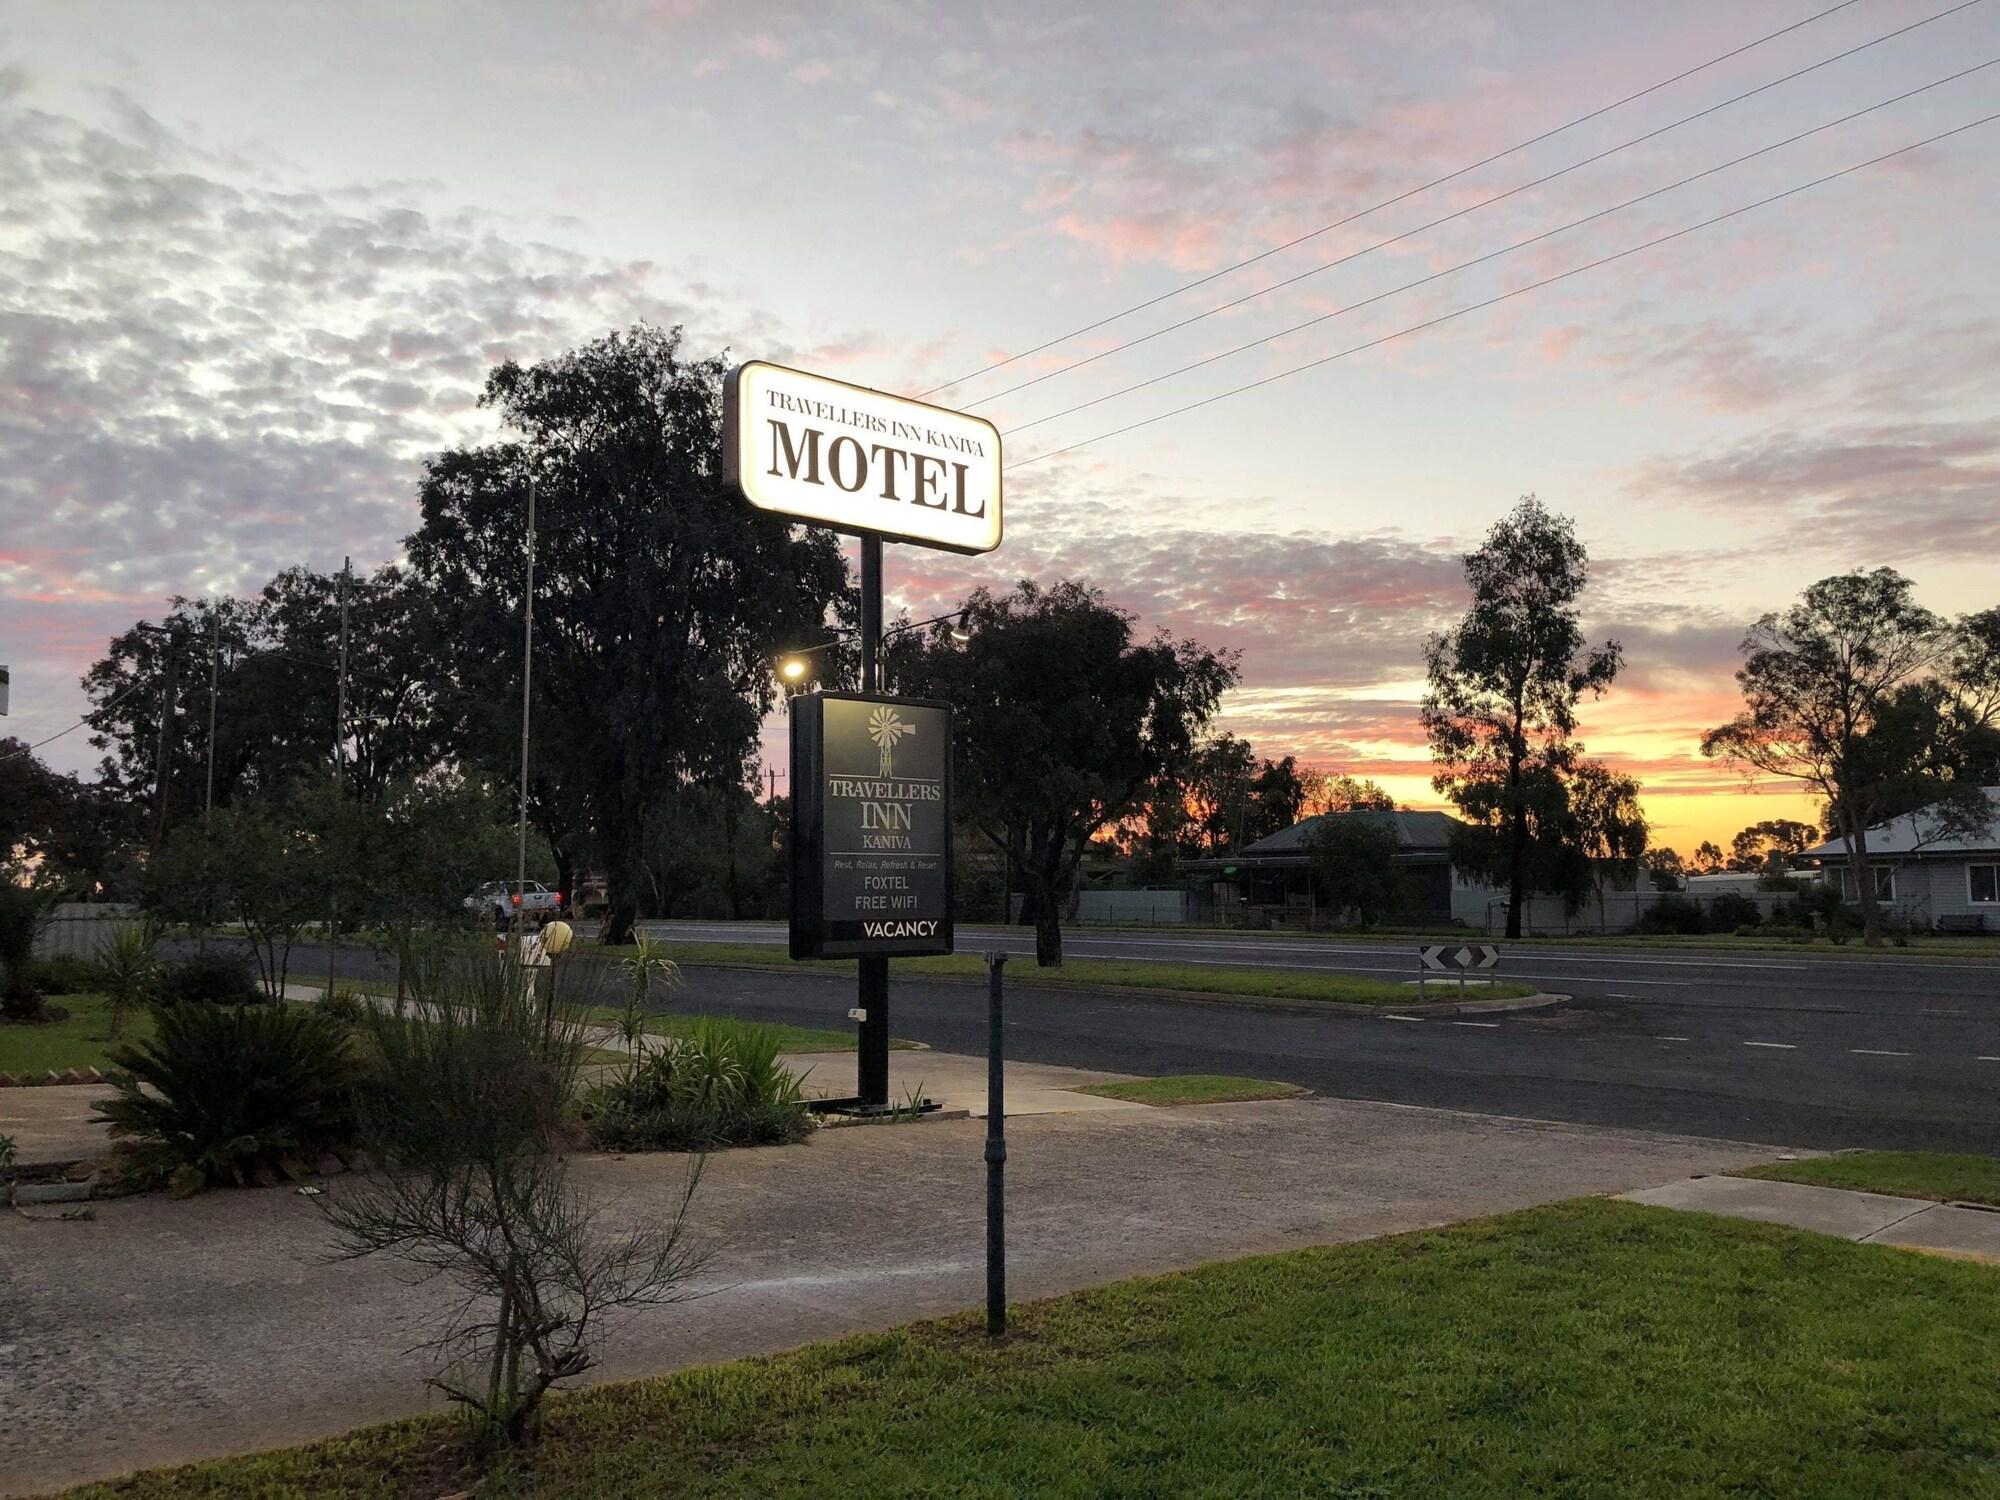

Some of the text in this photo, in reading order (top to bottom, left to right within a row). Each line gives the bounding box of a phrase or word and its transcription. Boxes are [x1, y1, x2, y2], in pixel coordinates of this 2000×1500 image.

[767, 390, 984, 457] TRAVELLERS INN KANIVA
[767, 419, 985, 518] MOTEL
[829, 780, 940, 800] TRAVELLERS
[861, 802, 912, 830] INN
[864, 835, 911, 848] KANIVA
[865, 876, 909, 889] FOXTEL
[856, 896, 917, 909] FREE WIFI
[864, 921, 937, 937] VACANCY
